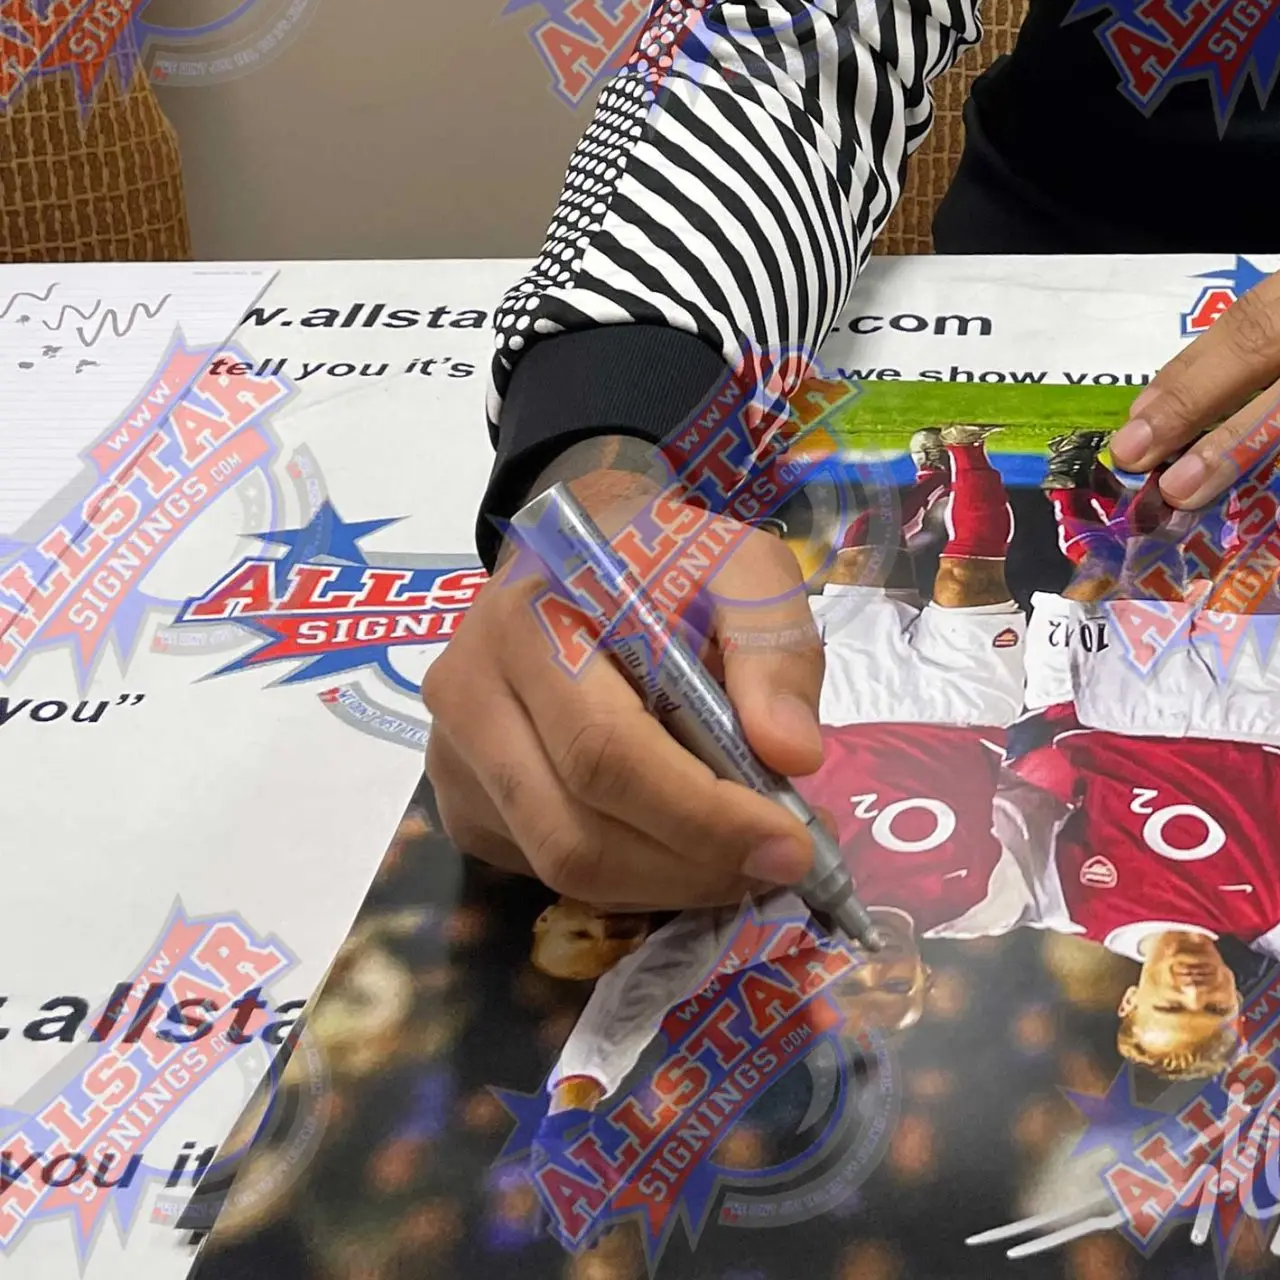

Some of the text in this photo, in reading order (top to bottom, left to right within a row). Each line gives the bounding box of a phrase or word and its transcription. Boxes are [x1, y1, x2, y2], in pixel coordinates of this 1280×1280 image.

[208, 358, 288, 376] tell
[294, 362, 388, 381] you
[919, 366, 1048, 384] show
[297, 612, 458, 644] SIGNI
[1080, 623, 1110, 653] 10
